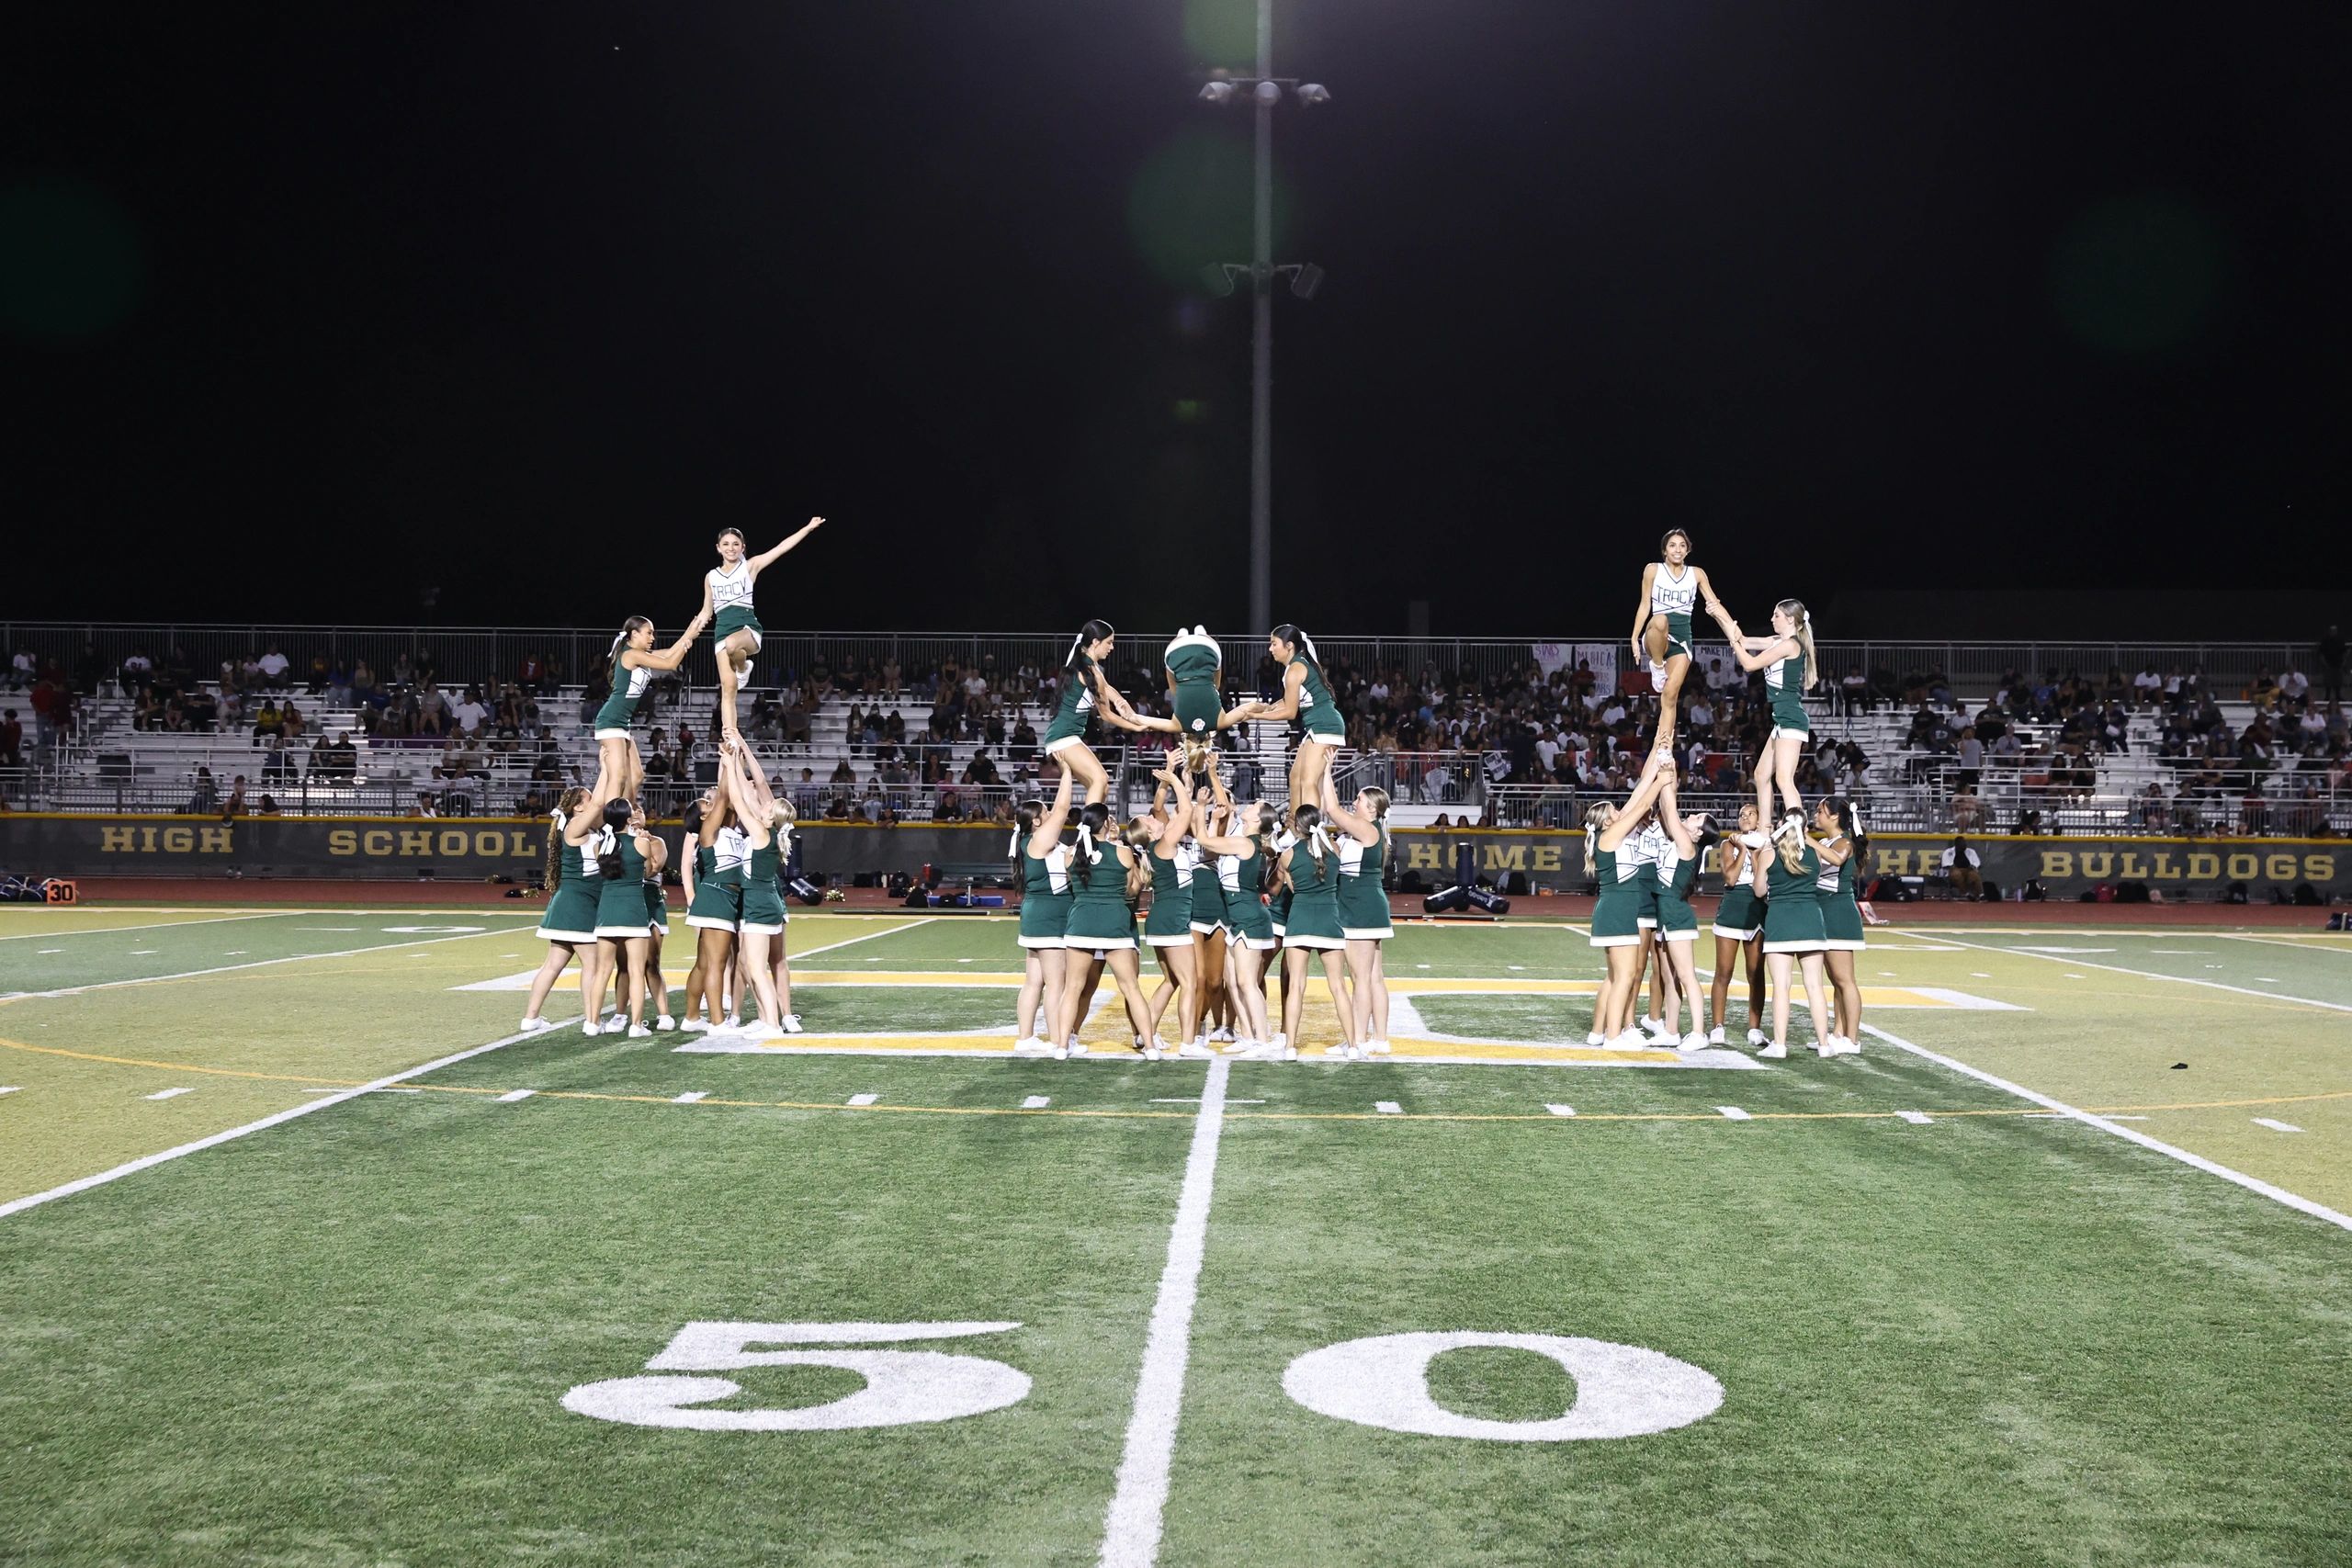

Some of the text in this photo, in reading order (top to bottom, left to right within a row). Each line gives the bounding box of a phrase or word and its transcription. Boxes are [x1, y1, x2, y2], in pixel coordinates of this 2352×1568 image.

[712, 577, 747, 599] TRACY
[1657, 584, 1695, 606] TRACY
[101, 827, 537, 856] HIGH SCHOOL
[2041, 852, 2335, 880] BULLDOGS
[50, 884, 74, 902] 30
[561, 1322, 1723, 1440] 5 0
